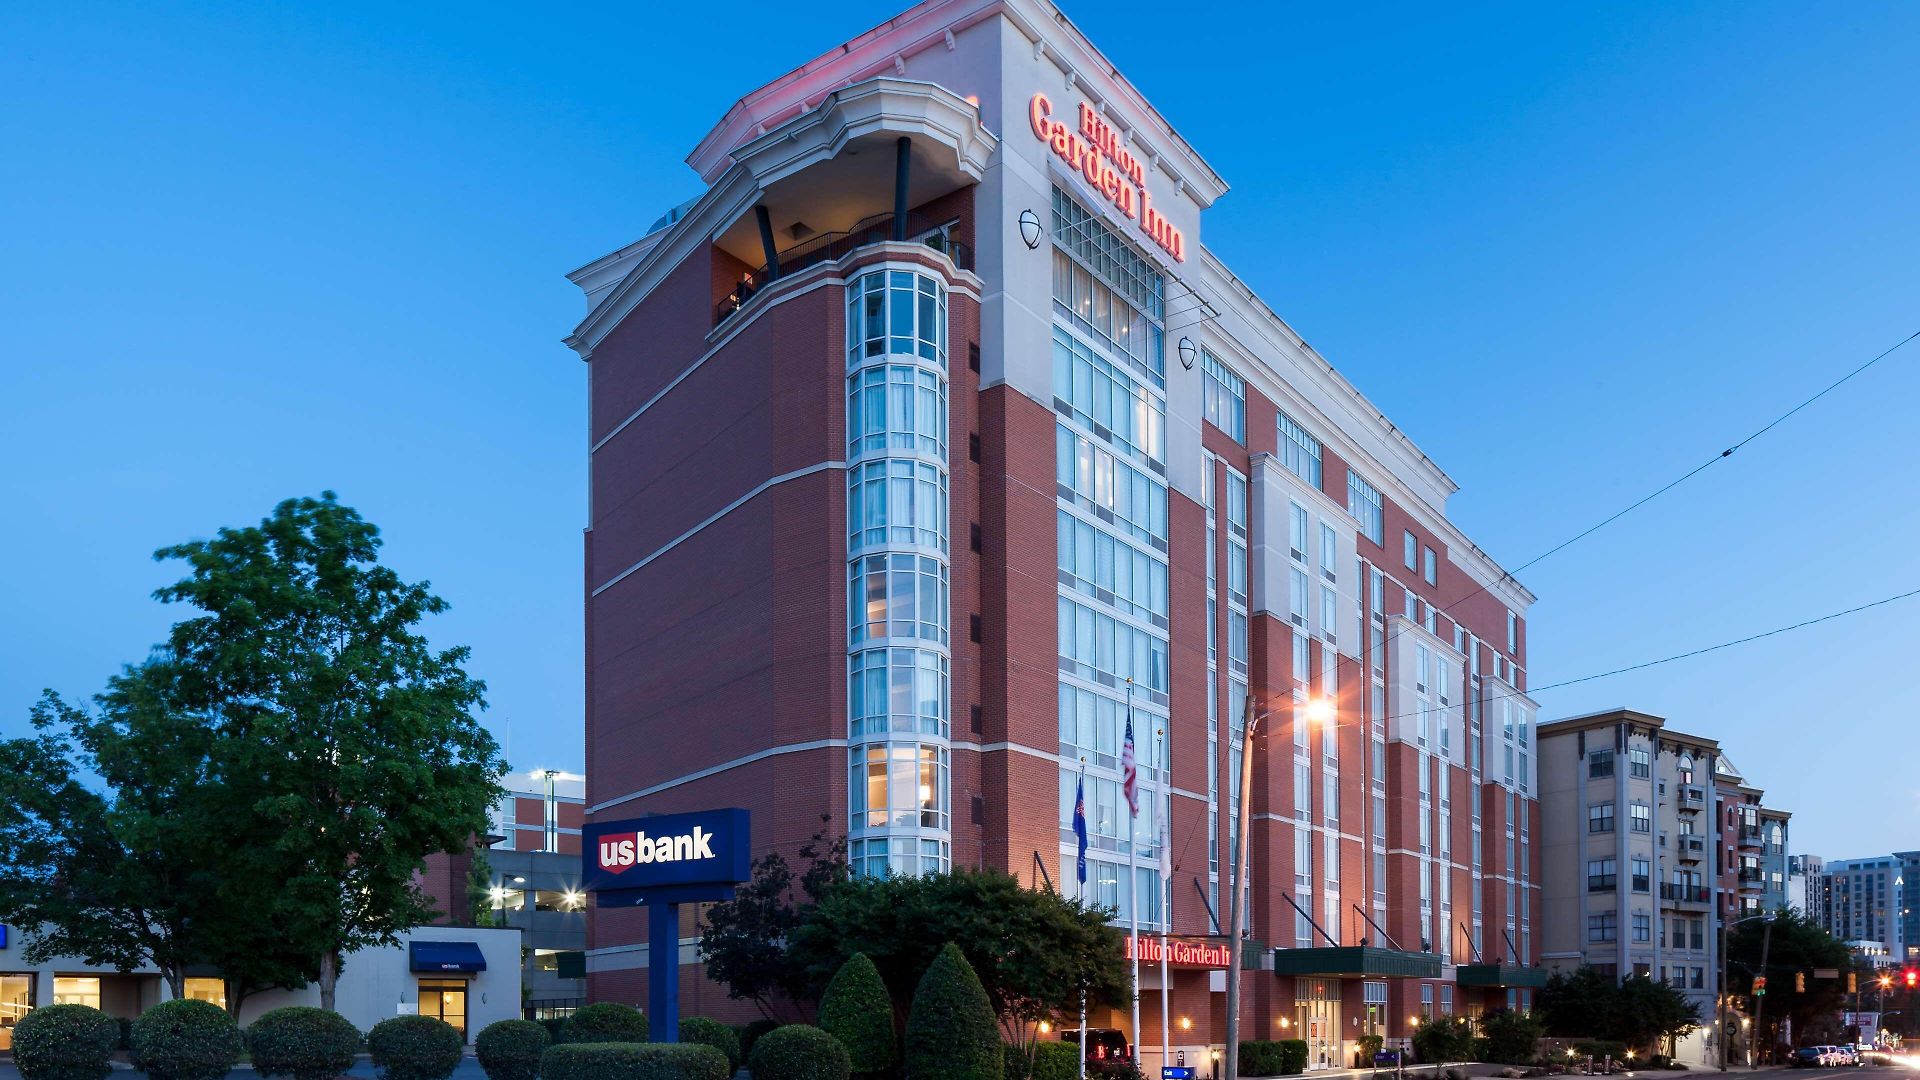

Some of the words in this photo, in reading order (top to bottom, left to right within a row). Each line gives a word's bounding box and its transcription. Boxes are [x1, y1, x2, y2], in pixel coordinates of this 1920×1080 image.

[1029, 94, 1135, 220] Garden
[1138, 189, 1184, 263] Inn
[1078, 101, 1145, 188] Hilton
[1174, 941, 1219, 965] Garden
[1220, 945, 1231, 966] In
